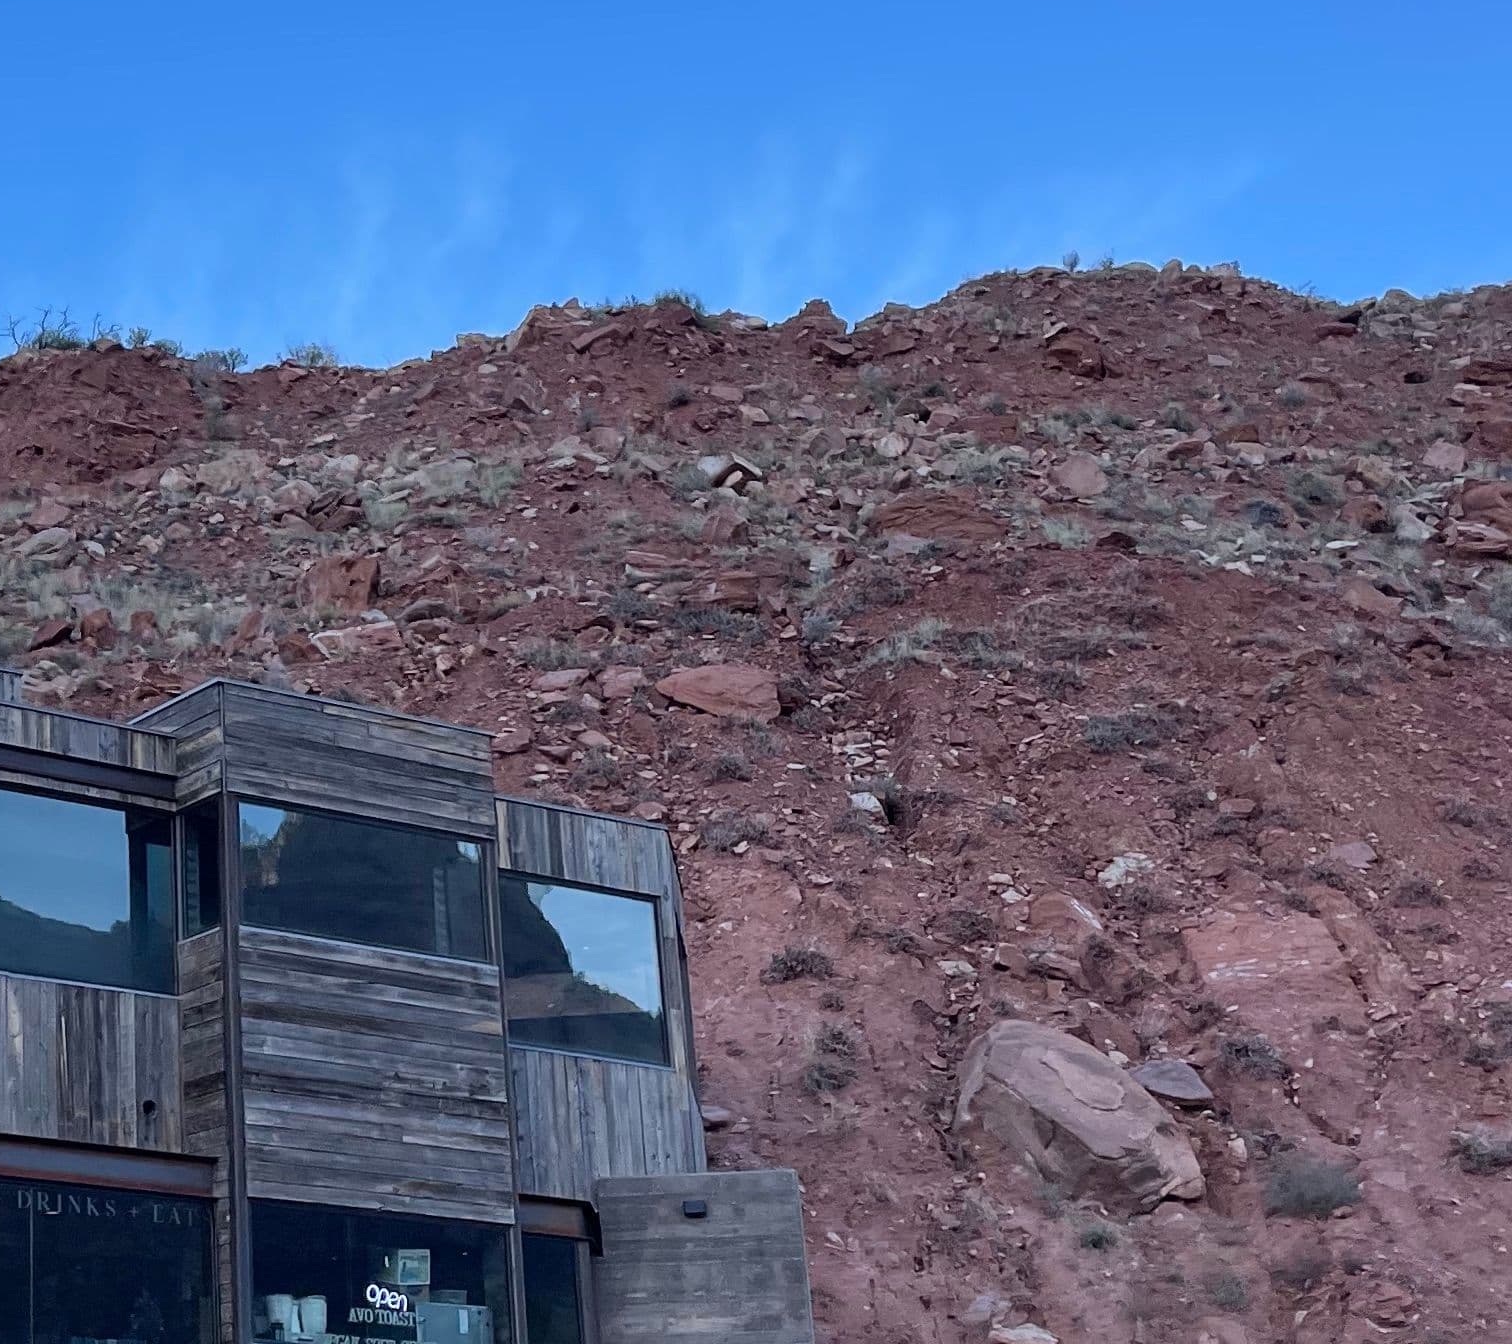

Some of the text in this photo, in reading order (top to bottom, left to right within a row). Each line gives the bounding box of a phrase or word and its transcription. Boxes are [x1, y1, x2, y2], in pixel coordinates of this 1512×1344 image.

[17, 1189, 116, 1217] DRINKS
[348, 1307, 416, 1327] AVO TOAST
